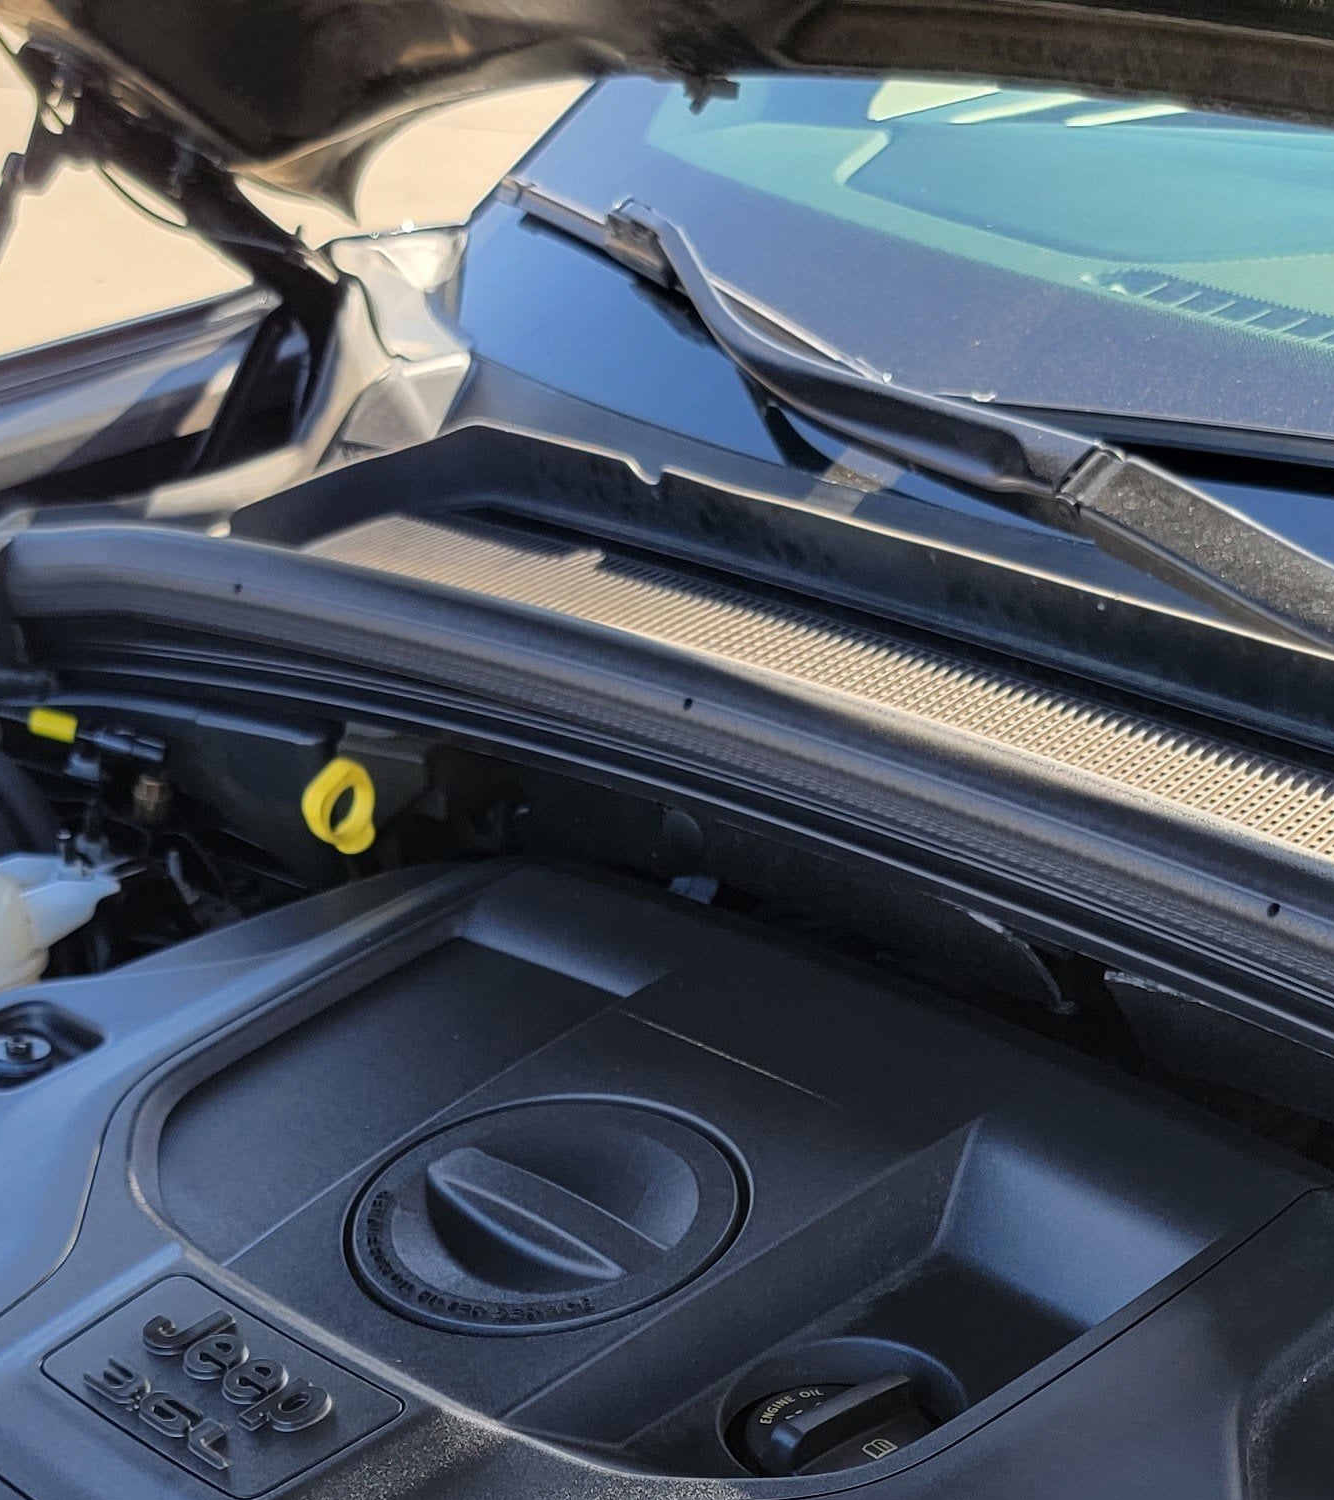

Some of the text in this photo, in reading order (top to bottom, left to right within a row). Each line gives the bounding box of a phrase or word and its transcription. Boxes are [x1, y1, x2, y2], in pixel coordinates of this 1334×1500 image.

[82, 1357, 231, 1472] 3.6L
[142, 1309, 333, 1433] Jeep
[759, 1395, 796, 1425] ENGINE
[798, 1389, 825, 1398] OIL
